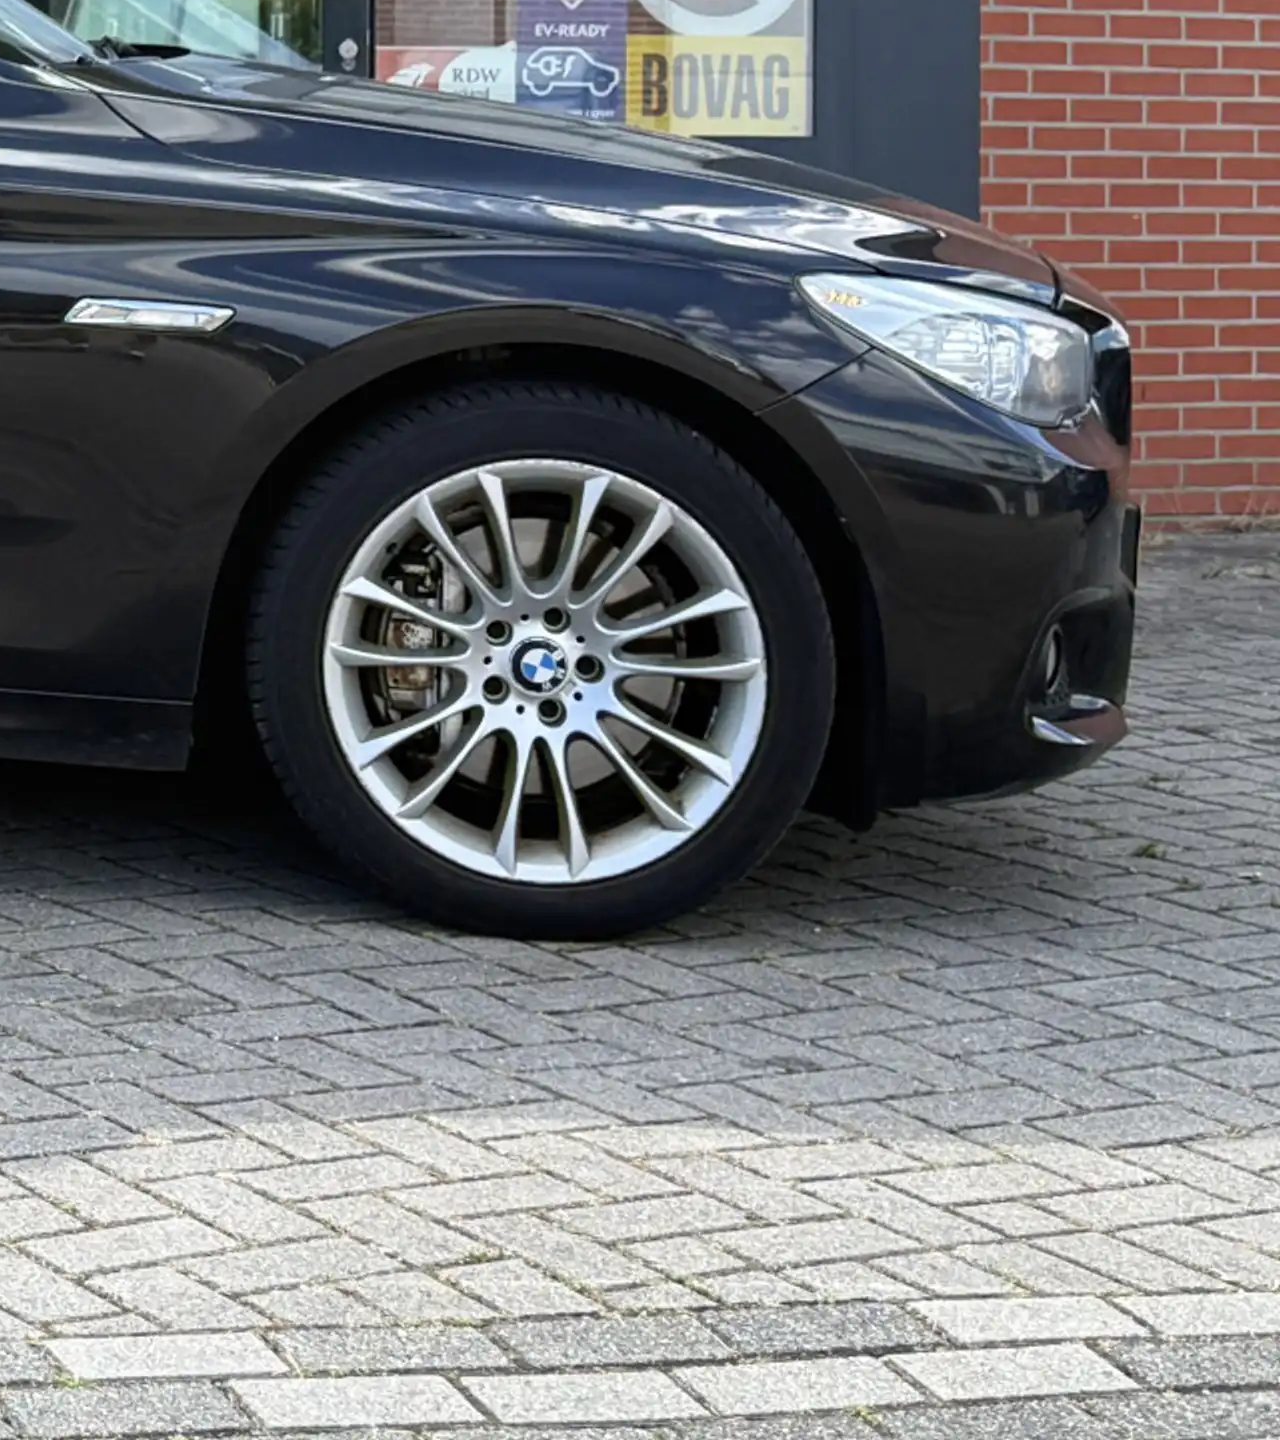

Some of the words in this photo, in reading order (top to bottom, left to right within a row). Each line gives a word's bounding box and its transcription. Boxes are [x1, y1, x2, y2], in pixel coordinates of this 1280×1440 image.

[534, 22, 610, 38] EV-READY
[452, 67, 501, 83] RDW
[641, 52, 791, 120] BOVAG
